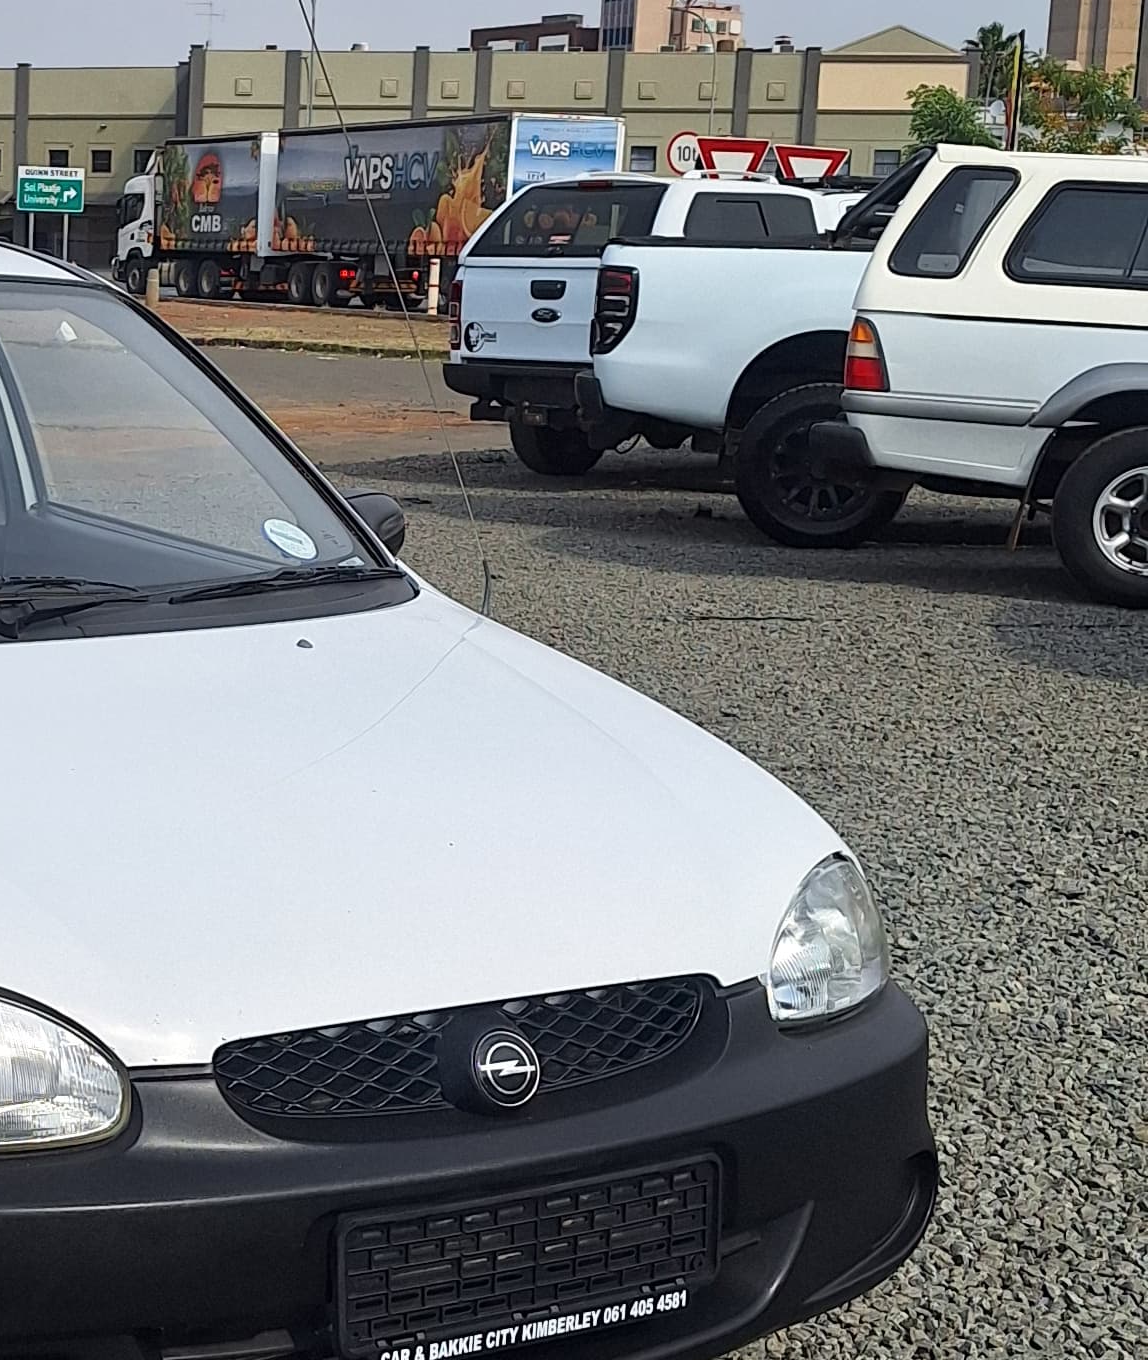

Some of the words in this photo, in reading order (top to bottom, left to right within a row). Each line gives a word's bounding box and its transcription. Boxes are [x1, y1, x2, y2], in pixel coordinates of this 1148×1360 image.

[50, 169, 79, 177] STREET
[23, 194, 59, 207] University
[191, 214, 222, 233] CMB
[485, 1326, 519, 1350] CITY
[521, 1308, 602, 1342] KIMBERLEY
[603, 1303, 627, 1325] 061
[629, 1297, 654, 1319] 405
[656, 1289, 688, 1312] 4581
